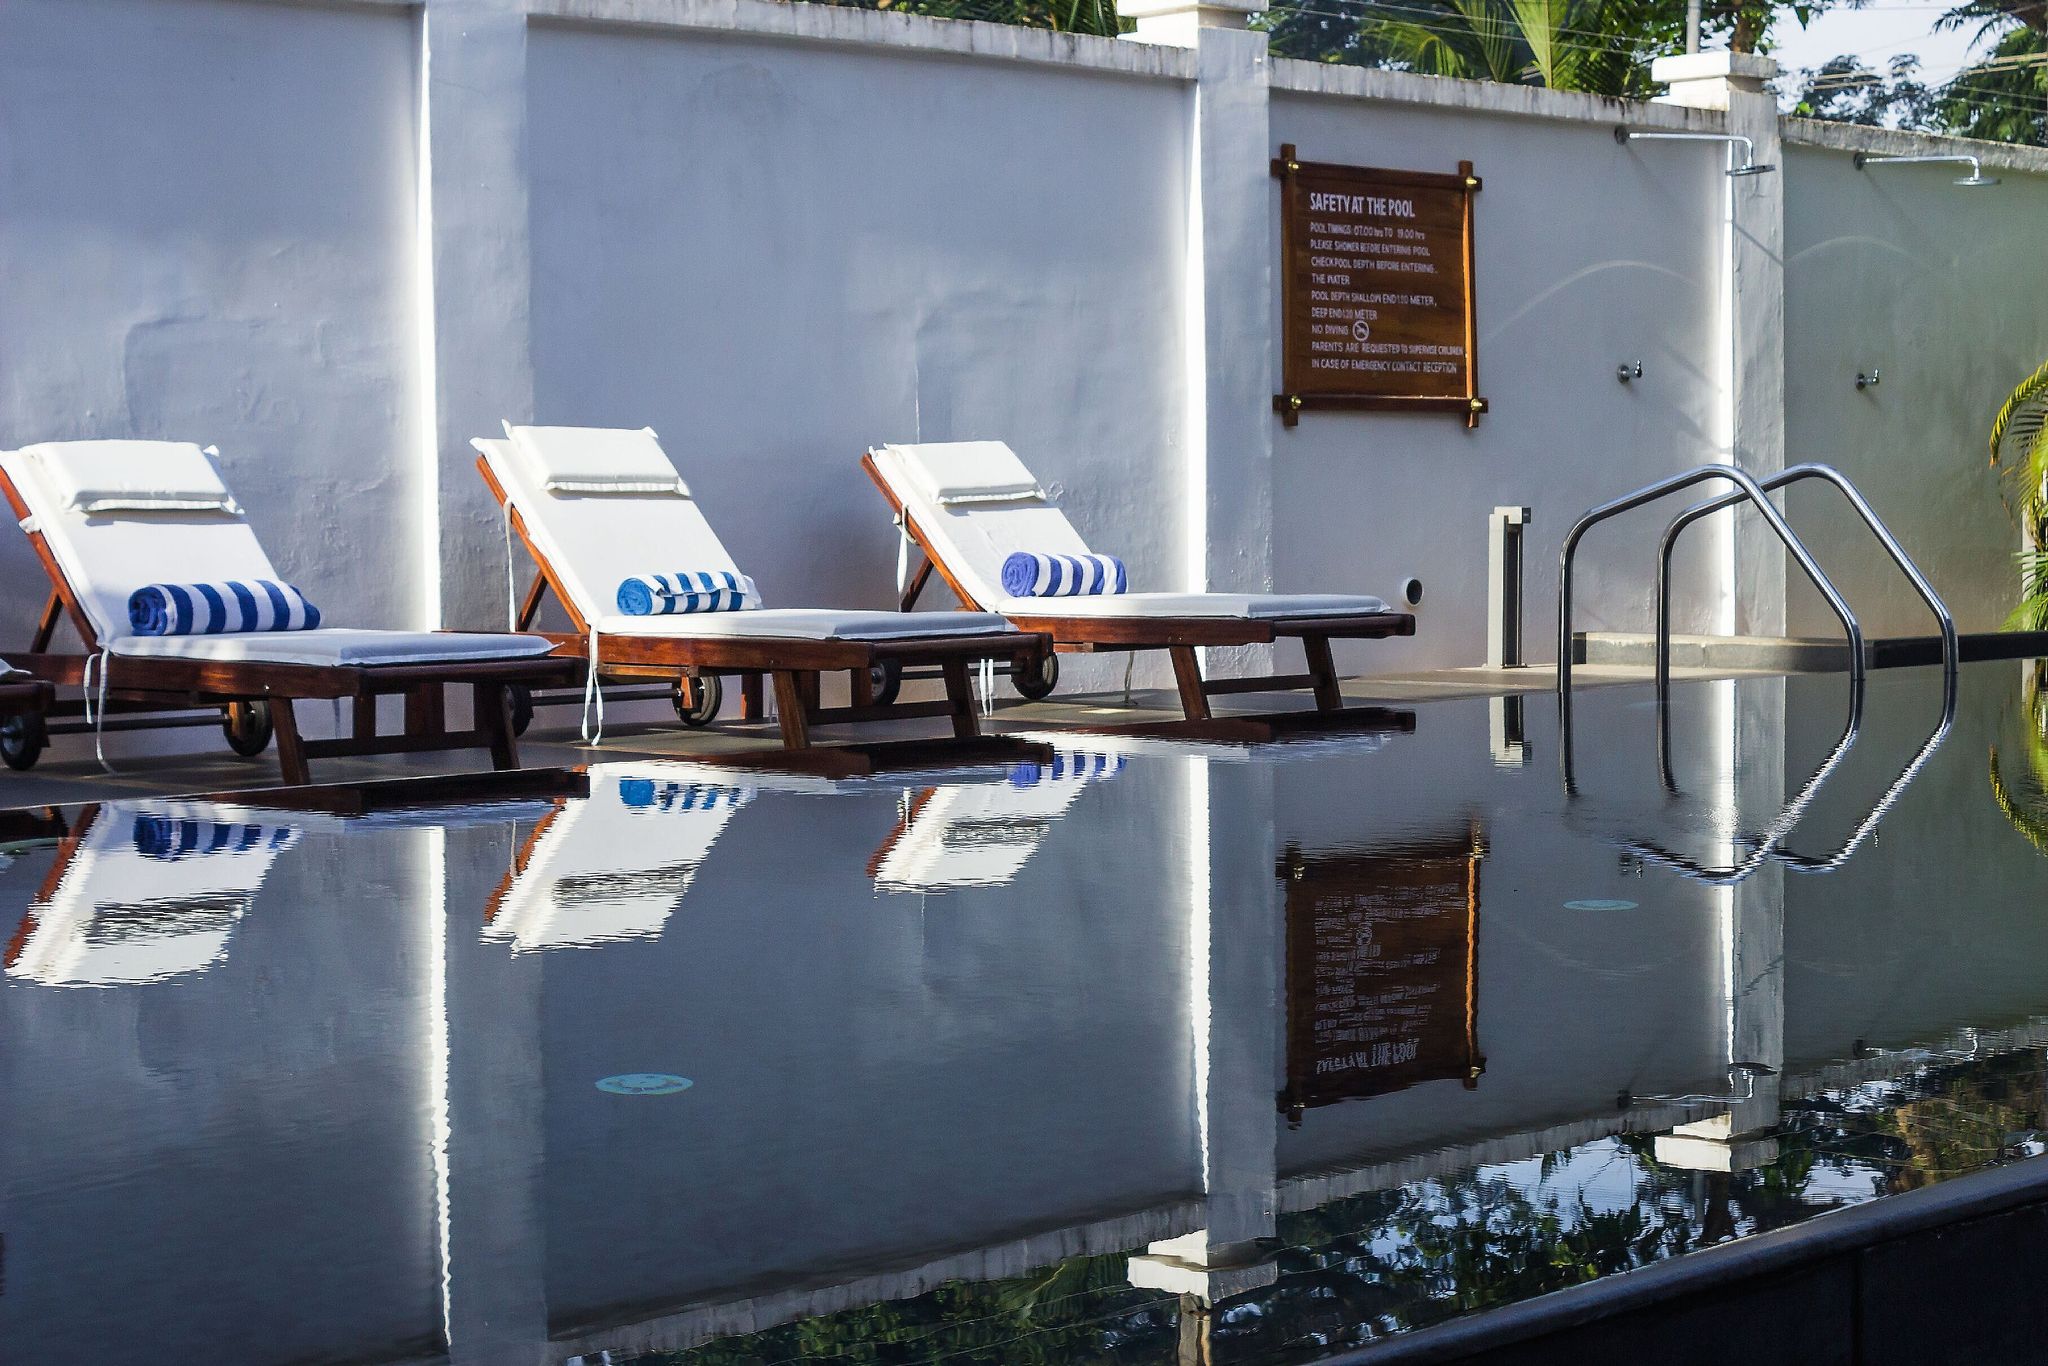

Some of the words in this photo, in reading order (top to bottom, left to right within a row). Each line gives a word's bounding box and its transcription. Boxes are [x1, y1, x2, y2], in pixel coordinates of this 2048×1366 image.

[1310, 192, 1351, 213] SAFETY
[1351, 196, 1365, 214] AT
[1366, 197, 1387, 216] THE
[1388, 199, 1416, 218] POOL
[1310, 222, 1327, 234] POOL
[1384, 226, 1393, 238] TO
[1310, 239, 1333, 250] PLEASE
[1360, 242, 1381, 253] BEFORE
[1381, 244, 1411, 256] ENTERING
[1311, 256, 1335, 267] CHECK
[1335, 258, 1352, 268] POOL
[1353, 259, 1375, 270] DEPTH
[1376, 260, 1399, 271] BEFORE
[1312, 273, 1325, 284] THE
[1327, 274, 1350, 285] WATER
[1311, 290, 1329, 301] POOL
[1330, 291, 1350, 302] DEPTH
[1351, 292, 1381, 303] SHALLOW
[1382, 294, 1397, 304] END
[1311, 307, 1328, 318] DEEP
[1329, 308, 1343, 318] END
[1355, 309, 1377, 320] METER
[1312, 324, 1323, 335] NO
[1325, 325, 1348, 336] DIVING
[1345, 342, 1359, 353] ARE
[1362, 343, 1400, 354] REQUESTED
[1312, 359, 1320, 368] IN
[1321, 359, 1340, 370] CASE
[1340, 360, 1350, 369] OF
[1351, 360, 1391, 371] EMERGENCY
[1392, 361, 1421, 372] CONTACT
[1423, 362, 1457, 374] RECEPTION
